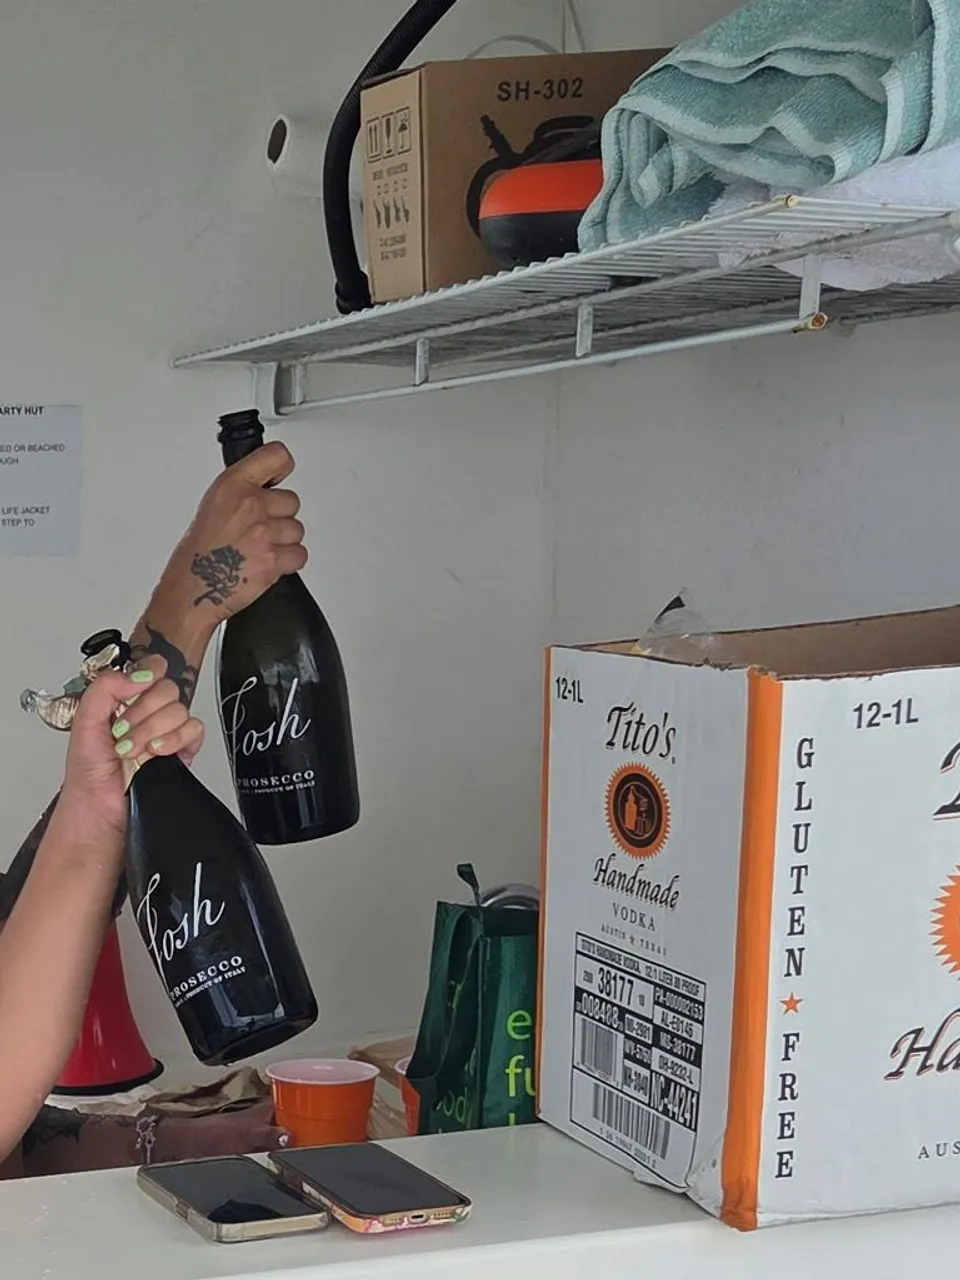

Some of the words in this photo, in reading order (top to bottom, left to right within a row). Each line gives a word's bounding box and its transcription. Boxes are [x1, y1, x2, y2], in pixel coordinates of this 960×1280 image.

[497, 77, 583, 102] SH-302
[24, 405, 44, 416] HUT
[13, 444, 26, 453] OR
[27, 443, 65, 452] BEACHED
[2, 507, 19, 515] LIFE
[21, 506, 50, 515] JACKET
[556, 676, 584, 703] 12-1L
[852, 698, 919, 729] 12-1L
[605, 702, 676, 758] Tito's
[783, 736, 815, 978] GLUTEN
[593, 853, 680, 909] Handmade
[612, 902, 656, 932] VODKA
[597, 965, 634, 1007] 38177
[650, 1071, 698, 1130] NC-44241
[775, 1032, 800, 1179] FREE
